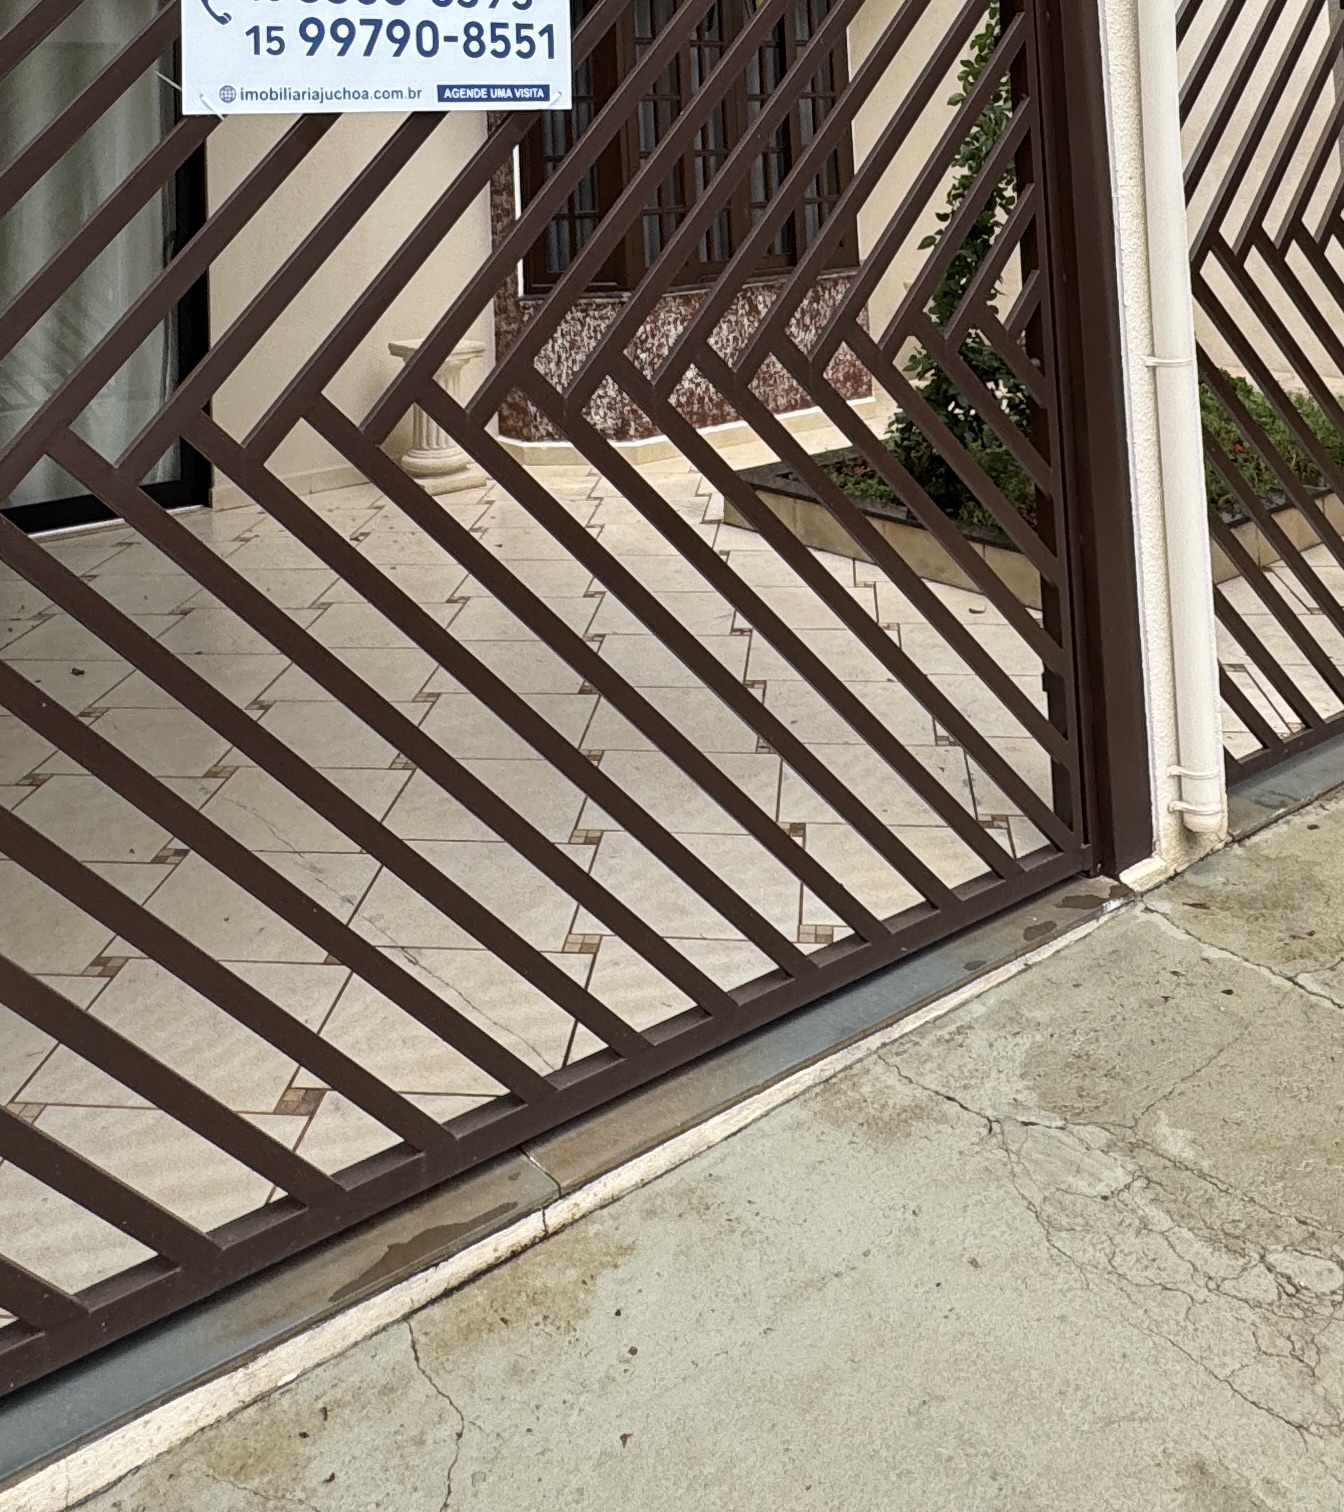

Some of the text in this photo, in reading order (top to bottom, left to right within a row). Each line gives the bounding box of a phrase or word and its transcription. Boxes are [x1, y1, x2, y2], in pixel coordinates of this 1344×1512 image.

[245, 16, 555, 60] 15 99790-8551
[239, 87, 423, 104] imobiliariajuchoa.com.br
[443, 87, 545, 99] AGENDE UMA VISITA
